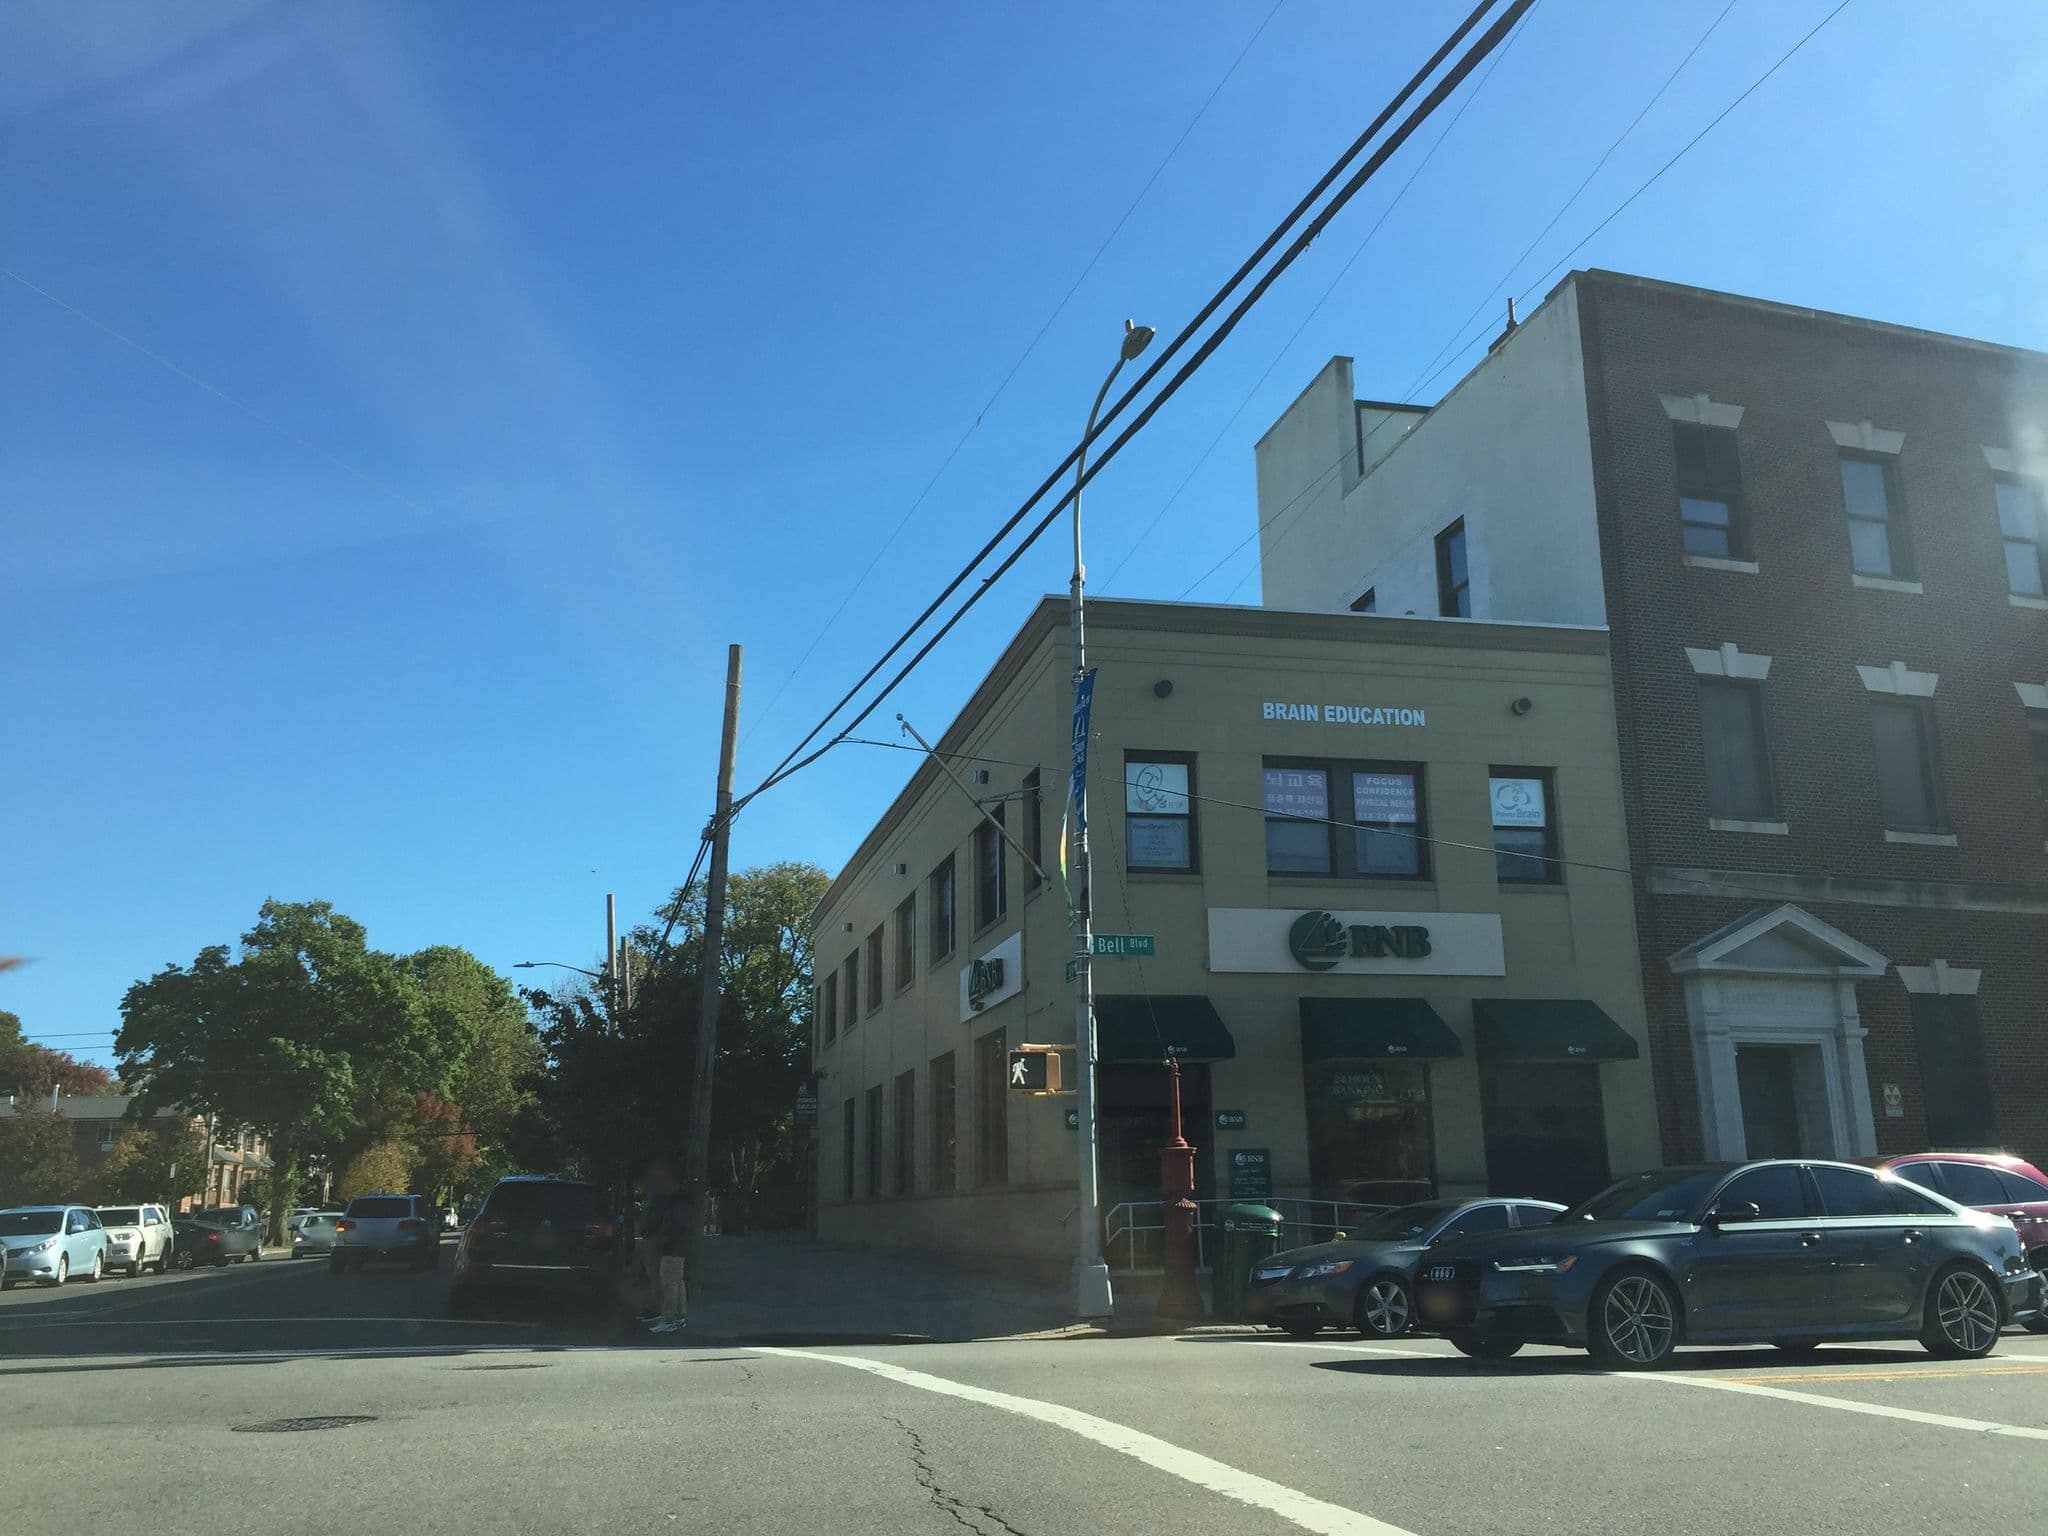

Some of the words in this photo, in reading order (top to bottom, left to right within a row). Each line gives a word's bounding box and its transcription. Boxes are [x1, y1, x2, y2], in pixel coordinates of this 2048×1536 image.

[1263, 702, 1319, 721] BRAIN
[1324, 705, 1426, 726] EDUCATION
[1366, 777, 1402, 786] FOCUS
[1516, 808, 1541, 819] Brain
[1098, 937, 1125, 953] Bell
[1129, 938, 1148, 948] Blvd
[1348, 925, 1432, 959] BNB
